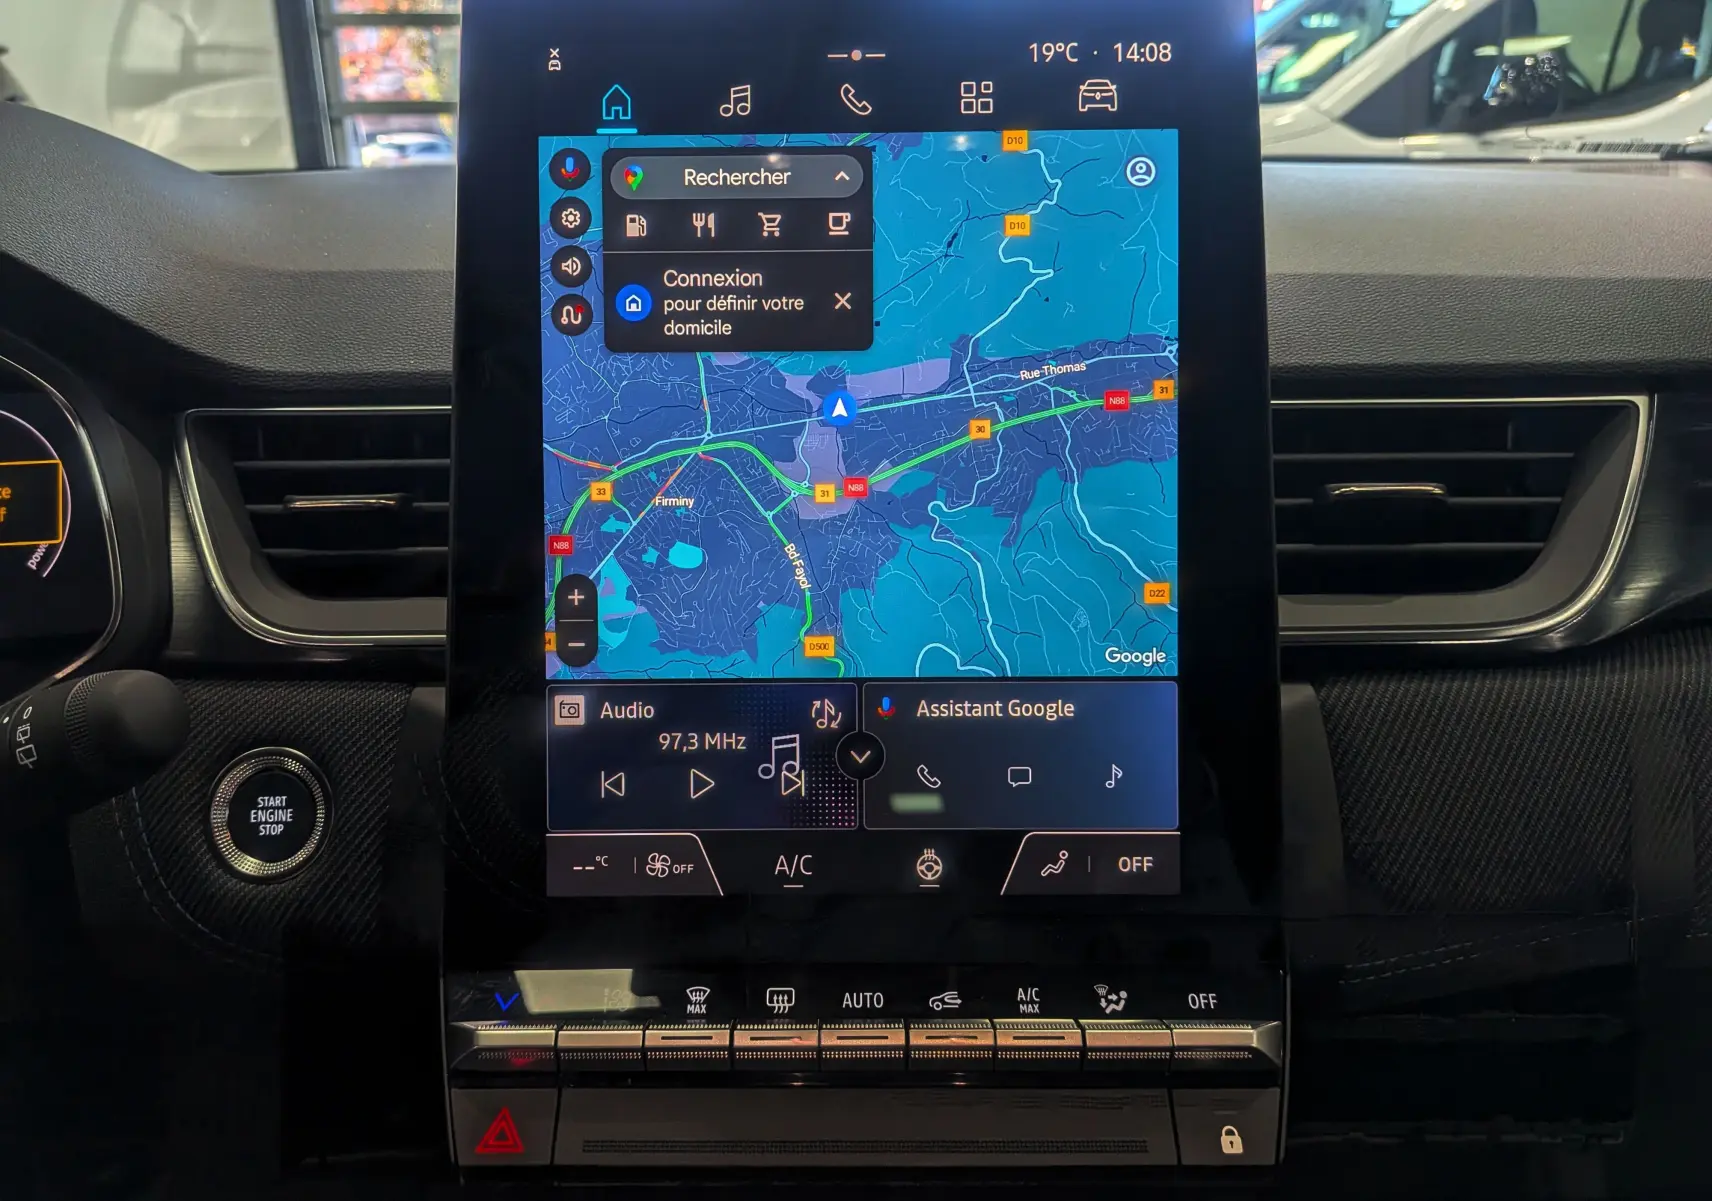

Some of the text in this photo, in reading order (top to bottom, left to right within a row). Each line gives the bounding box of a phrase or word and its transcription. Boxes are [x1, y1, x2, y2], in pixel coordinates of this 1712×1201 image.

[1029, 42, 1172, 62] 19°C 14:08
[1007, 136, 1024, 146] D10
[684, 168, 791, 186] Rechercher
[1009, 221, 1026, 231] D10
[663, 269, 763, 287] Connexion
[664, 294, 804, 314] pour définir votre
[664, 320, 732, 336] domicile
[1020, 362, 1087, 381] Rue Thomas
[1109, 396, 1126, 406] N88
[848, 483, 864, 492] N88
[655, 496, 694, 509] Firminy
[553, 541, 569, 550] N88
[784, 543, 812, 589] Bd Fayol
[1149, 589, 1165, 598] D22
[810, 642, 830, 652] D500
[1105, 647, 1166, 667] Google
[600, 701, 655, 719] Audio
[916, 699, 1075, 721] Assistant Google
[658, 732, 747, 753] 97,3 MHz
[257, 796, 287, 808] START
[250, 809, 293, 823] ENGINE
[258, 824, 284, 836] STOP
[672, 864, 694, 874] OFF
[774, 855, 812, 878] A/C
[1118, 857, 1154, 873] OFF
[842, 992, 884, 1009] AUTO
[1017, 988, 1040, 1003] A/C
[1188, 993, 1217, 1009] OFF
[687, 1004, 707, 1014] MAX
[1019, 1003, 1040, 1014] MAX
